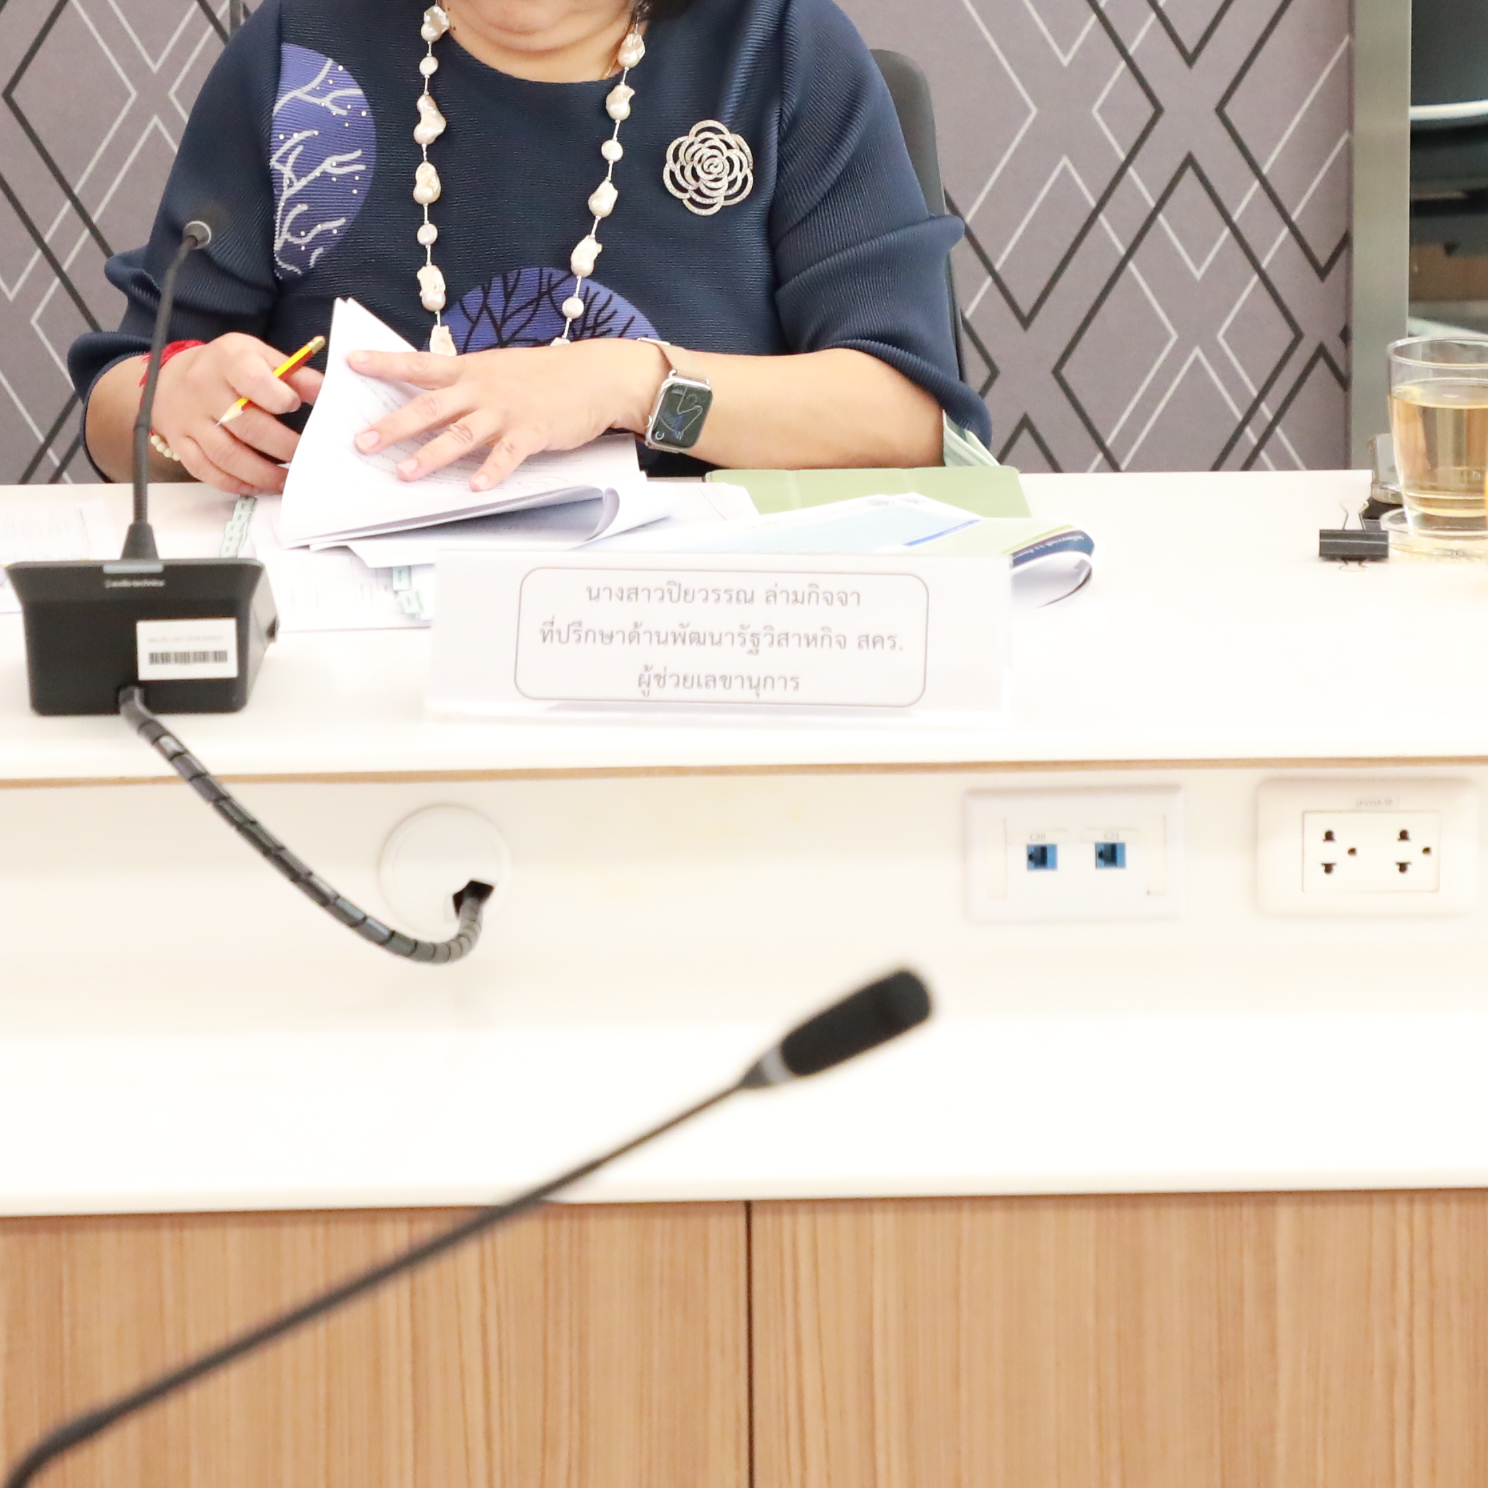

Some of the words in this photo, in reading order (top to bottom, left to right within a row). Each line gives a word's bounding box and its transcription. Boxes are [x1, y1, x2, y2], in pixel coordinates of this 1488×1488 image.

[585, 581, 755, 607] นางสาวปิยวรรณ
[764, 581, 862, 608] ล่ามกิจจา
[539, 615, 848, 656] ที่ปรึกษาด้านพัฒนารัฐวิสาหกิจ
[856, 631, 905, 652] สคร.
[637, 663, 801, 699] ผู้ช่วยเลขานุการ
